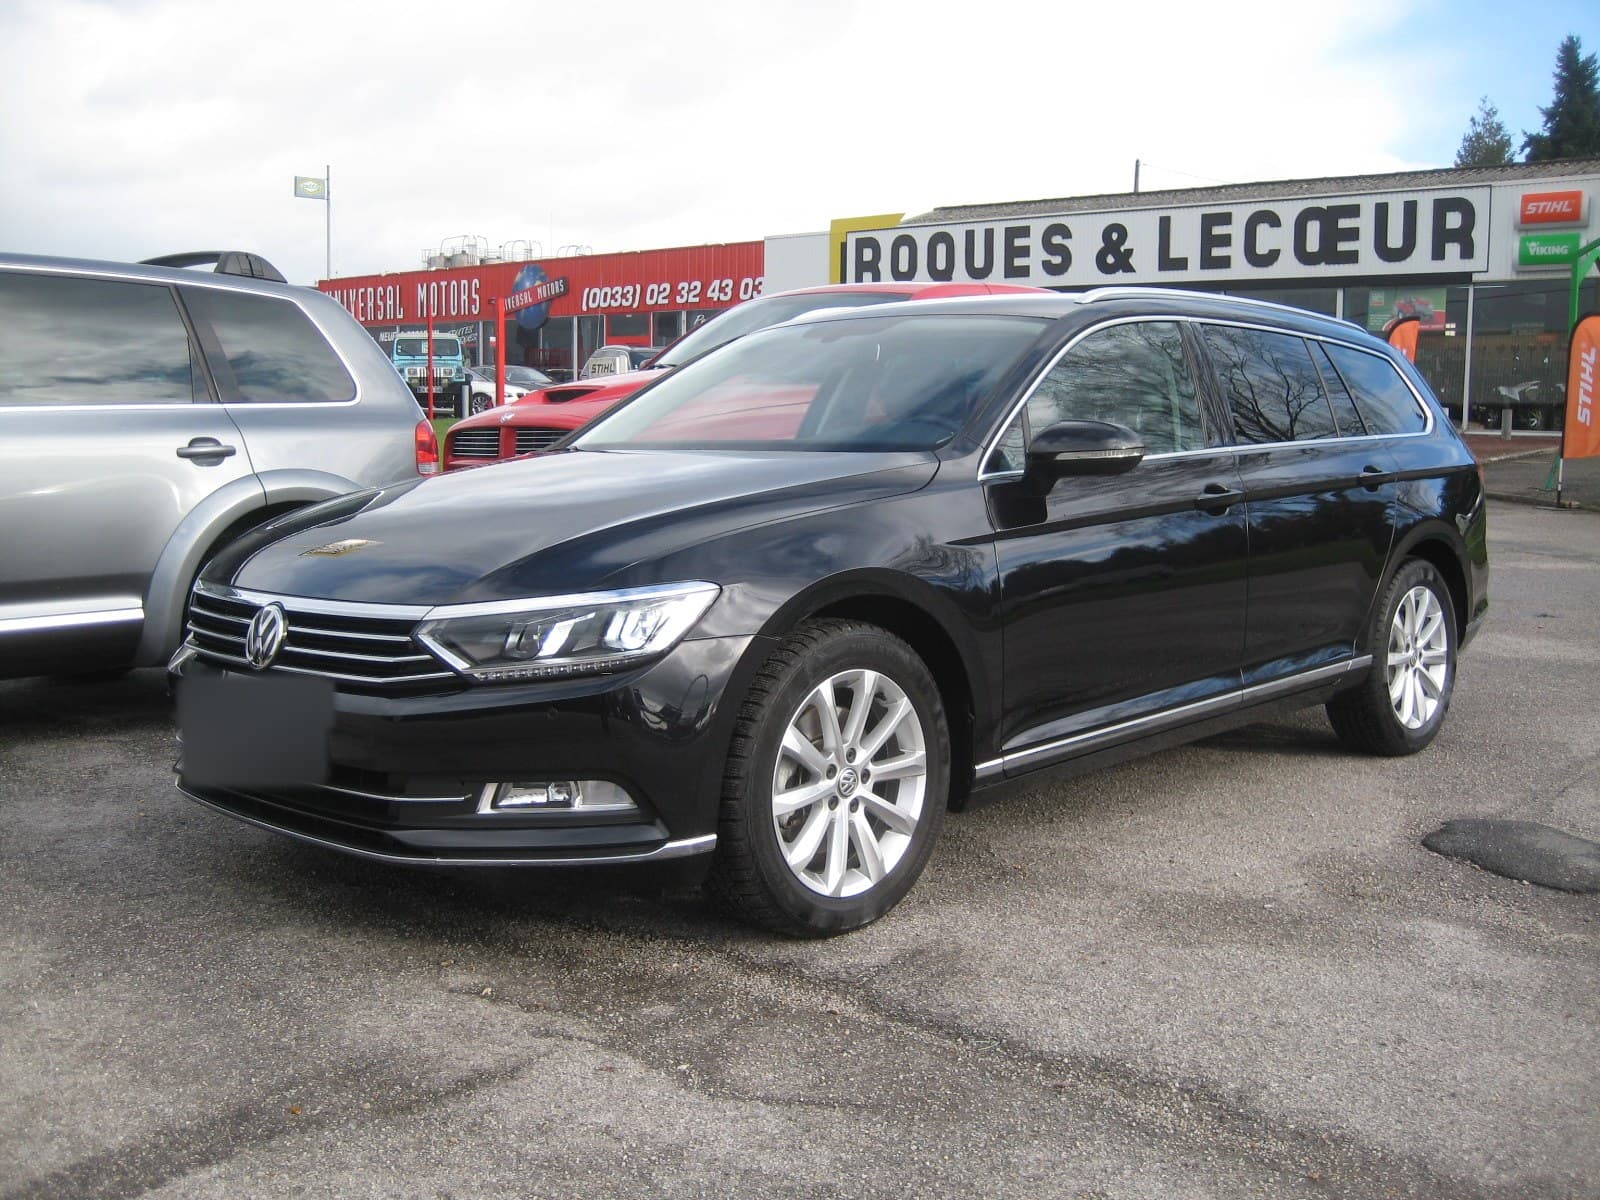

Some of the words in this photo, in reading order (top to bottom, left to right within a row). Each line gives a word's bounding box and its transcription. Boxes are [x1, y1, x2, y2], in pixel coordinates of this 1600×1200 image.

[1526, 200, 1572, 215] STIHL
[855, 222, 1072, 283] ROQUES
[1095, 222, 1136, 275] &
[1158, 197, 1476, 271] LECŒUR
[1527, 242, 1568, 256] VIKING
[327, 285, 404, 322] IVERSAL
[417, 278, 480, 318] MOTORS
[537, 279, 564, 299] MOTORS
[582, 284, 641, 311] (0033)
[646, 283, 670, 305] 02
[676, 280, 701, 304] 32
[706, 279, 734, 301] 43
[739, 276, 765, 300] 03
[591, 362, 615, 374] STIHL
[1577, 347, 1597, 426] STIHL
